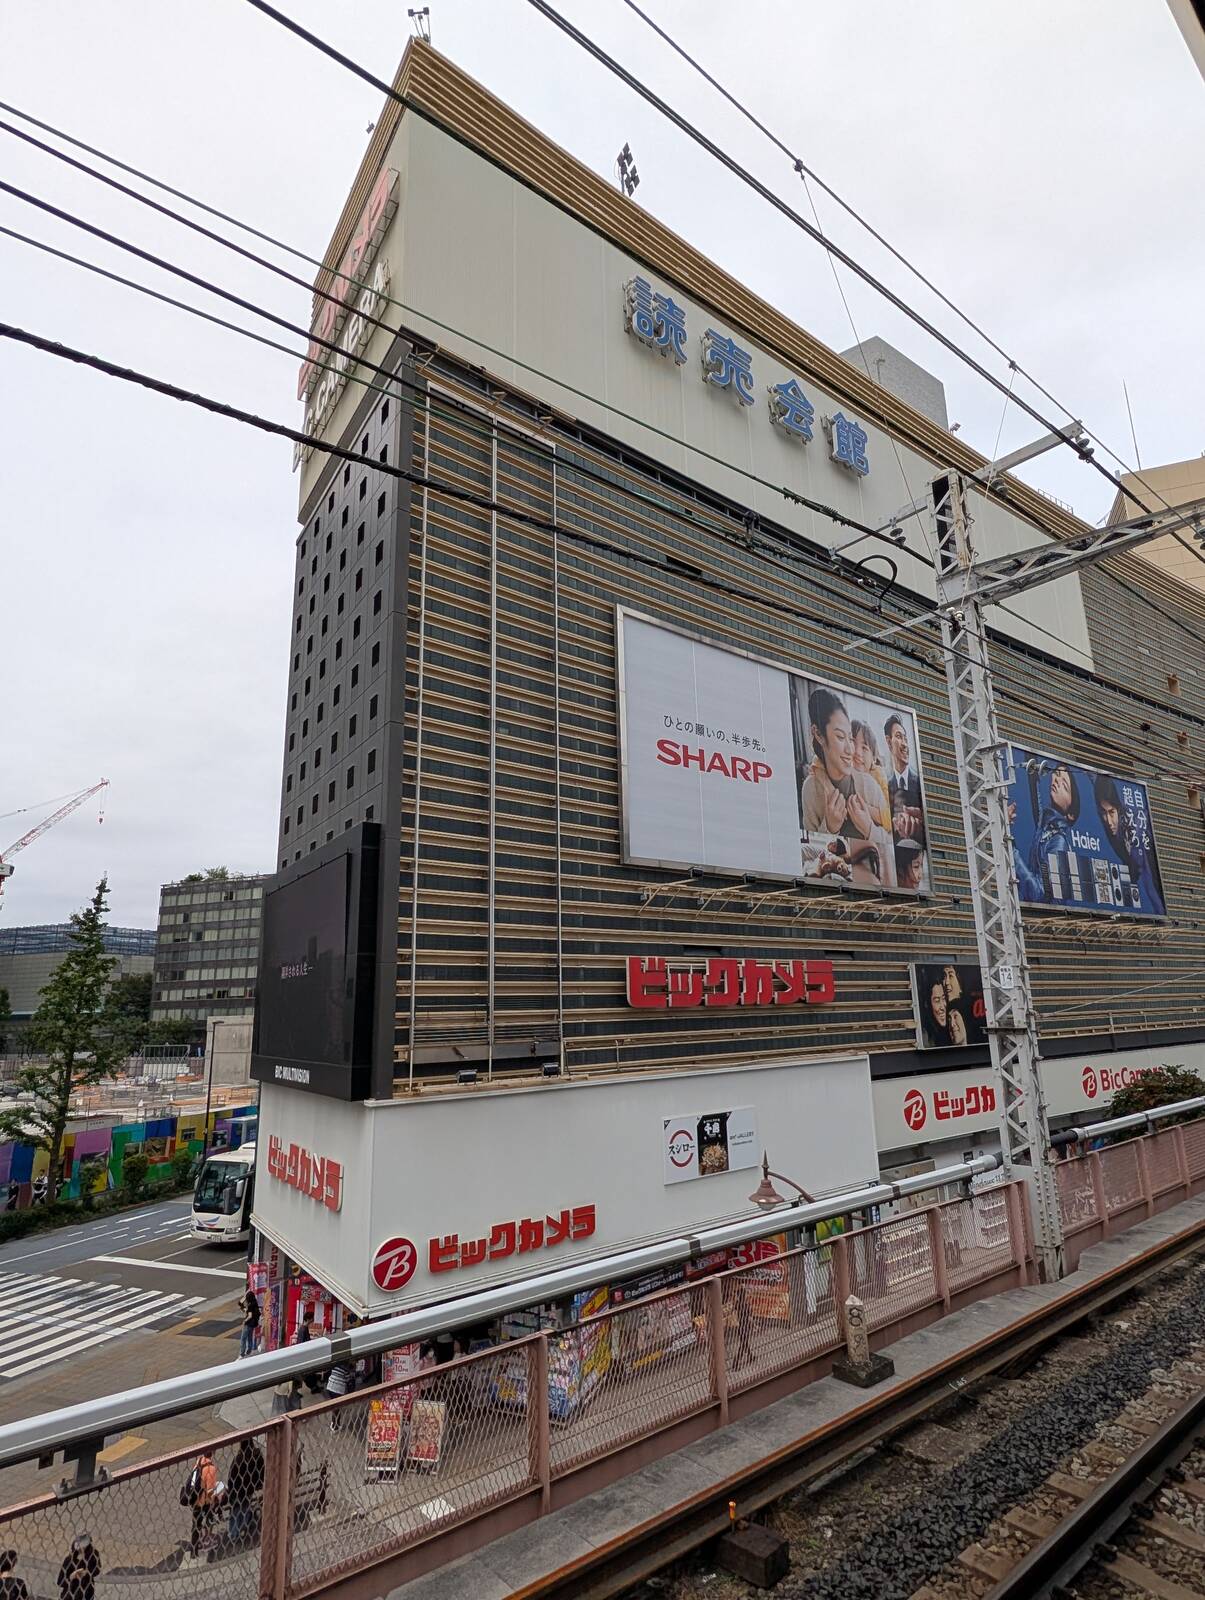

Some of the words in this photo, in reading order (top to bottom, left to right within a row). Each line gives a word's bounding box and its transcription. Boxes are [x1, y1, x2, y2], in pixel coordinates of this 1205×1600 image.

[627, 275, 870, 477] 読売会館
[663, 714, 767, 753] ひとの願いの、半歩先。
[656, 738, 773, 784] SHARP
[1071, 829, 1100, 852] Haier
[1122, 785, 1143, 856] 超えろ。
[1134, 789, 1150, 850] 自分を
[626, 956, 835, 1009] ビックカメラ
[1100, 1066, 1164, 1091] BicCa
[268, 1134, 343, 1212] ビックカメラ
[668, 1143, 696, 1156] スシロー
[429, 1203, 596, 1274] ビックカメラ
